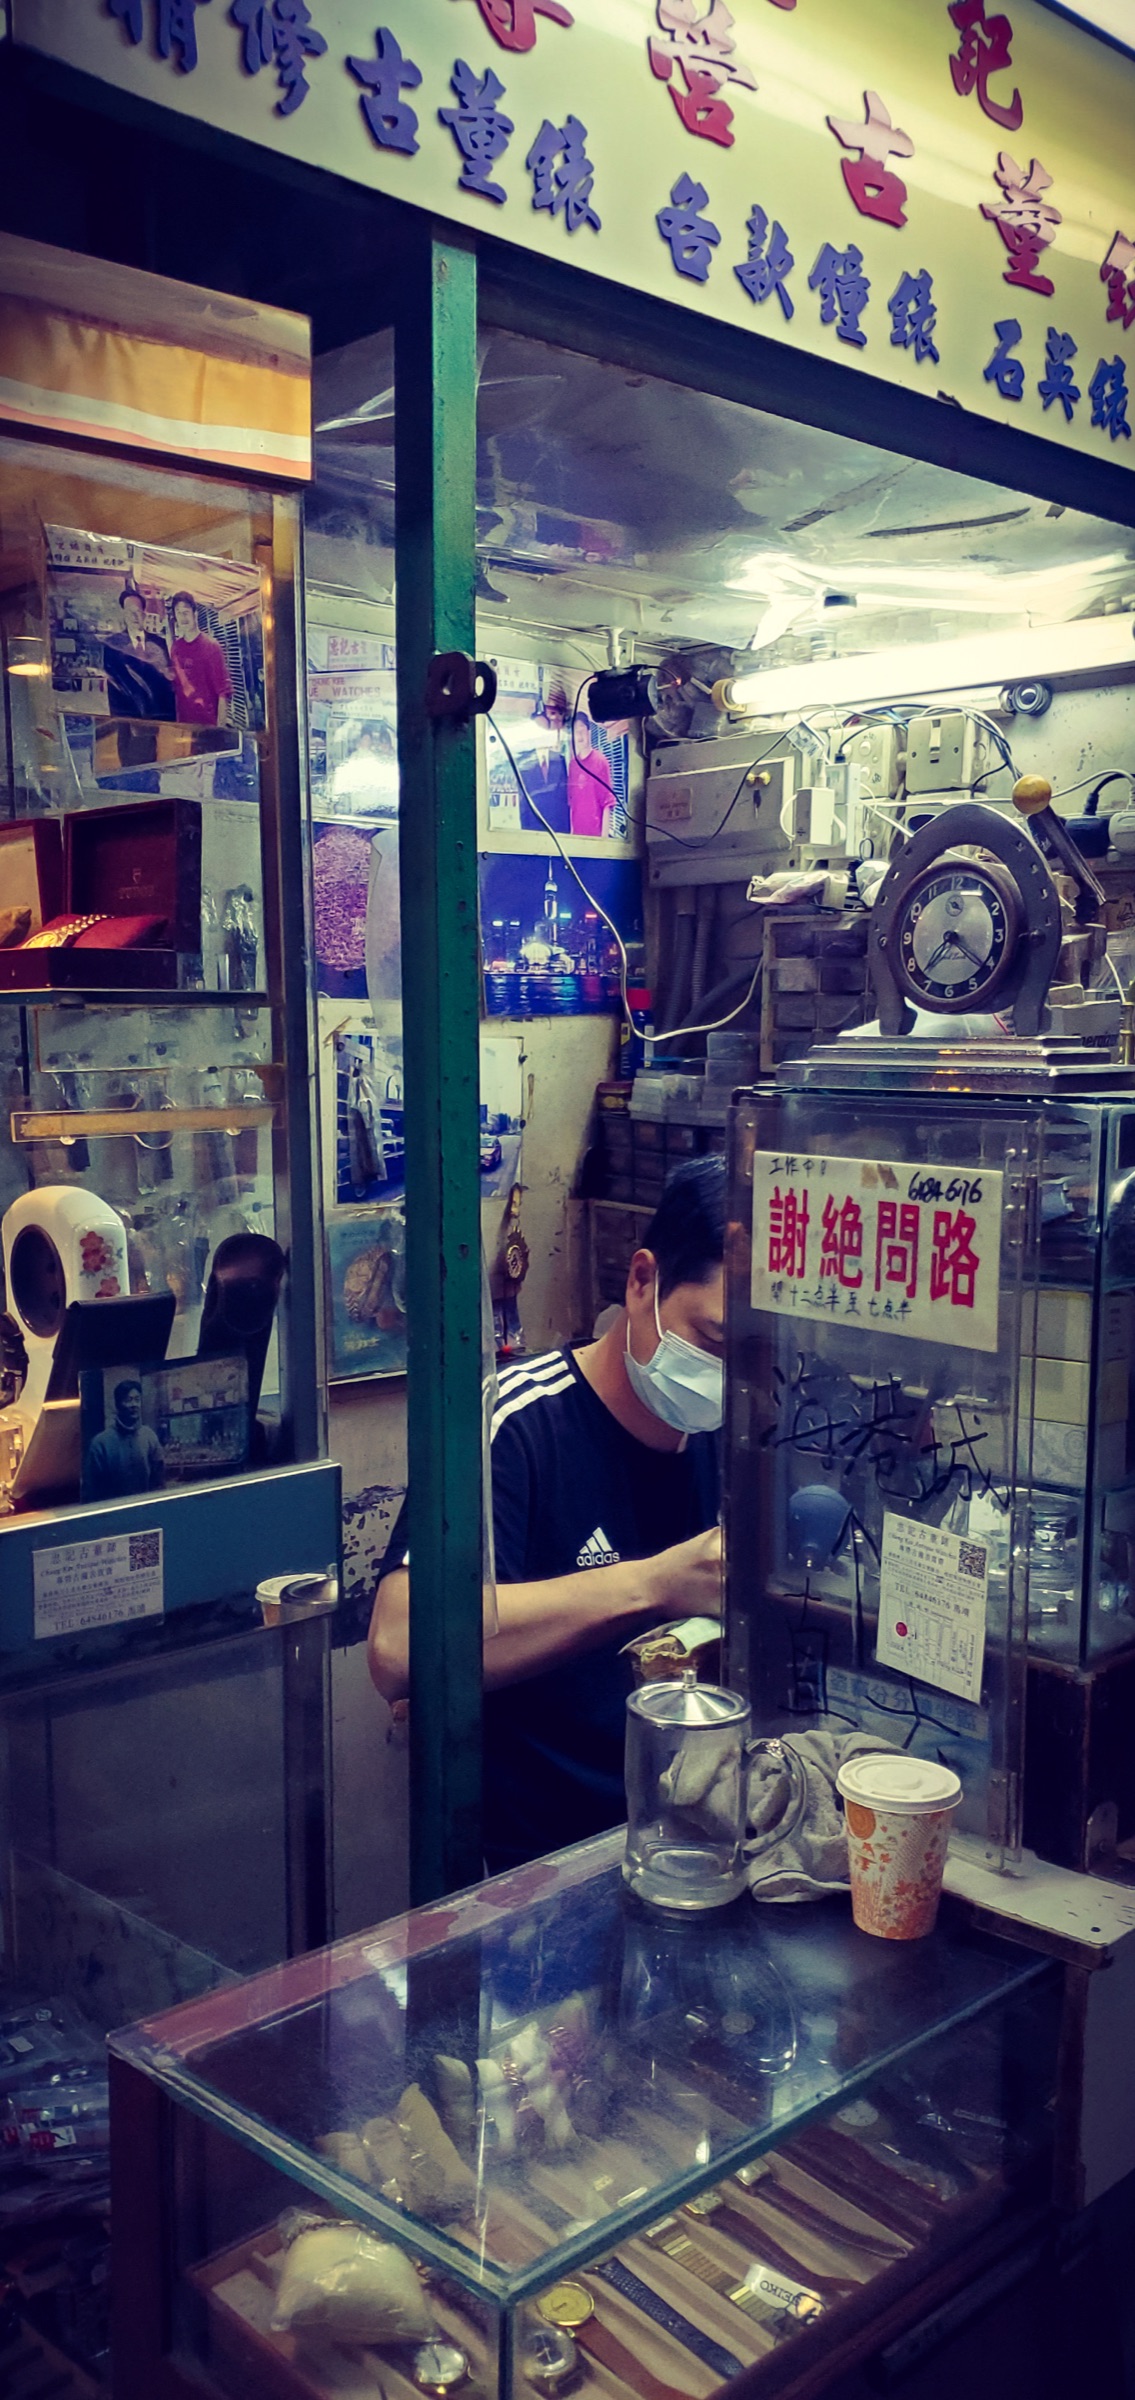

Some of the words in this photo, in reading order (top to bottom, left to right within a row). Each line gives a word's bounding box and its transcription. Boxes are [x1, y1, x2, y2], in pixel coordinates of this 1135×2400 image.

[984, 318, 1132, 440] 石英錶
[332, 687, 381, 697] WATCHES
[951, 877, 964, 890] 12
[991, 902, 1000, 916] 2
[903, 932, 912, 944] 9
[995, 929, 1004, 943] 3
[907, 957, 916, 972] 8
[944, 985, 954, 998] 6
[768, 1186, 980, 1308] 謝絕問路
[576, 1551, 620, 1567] adidas
